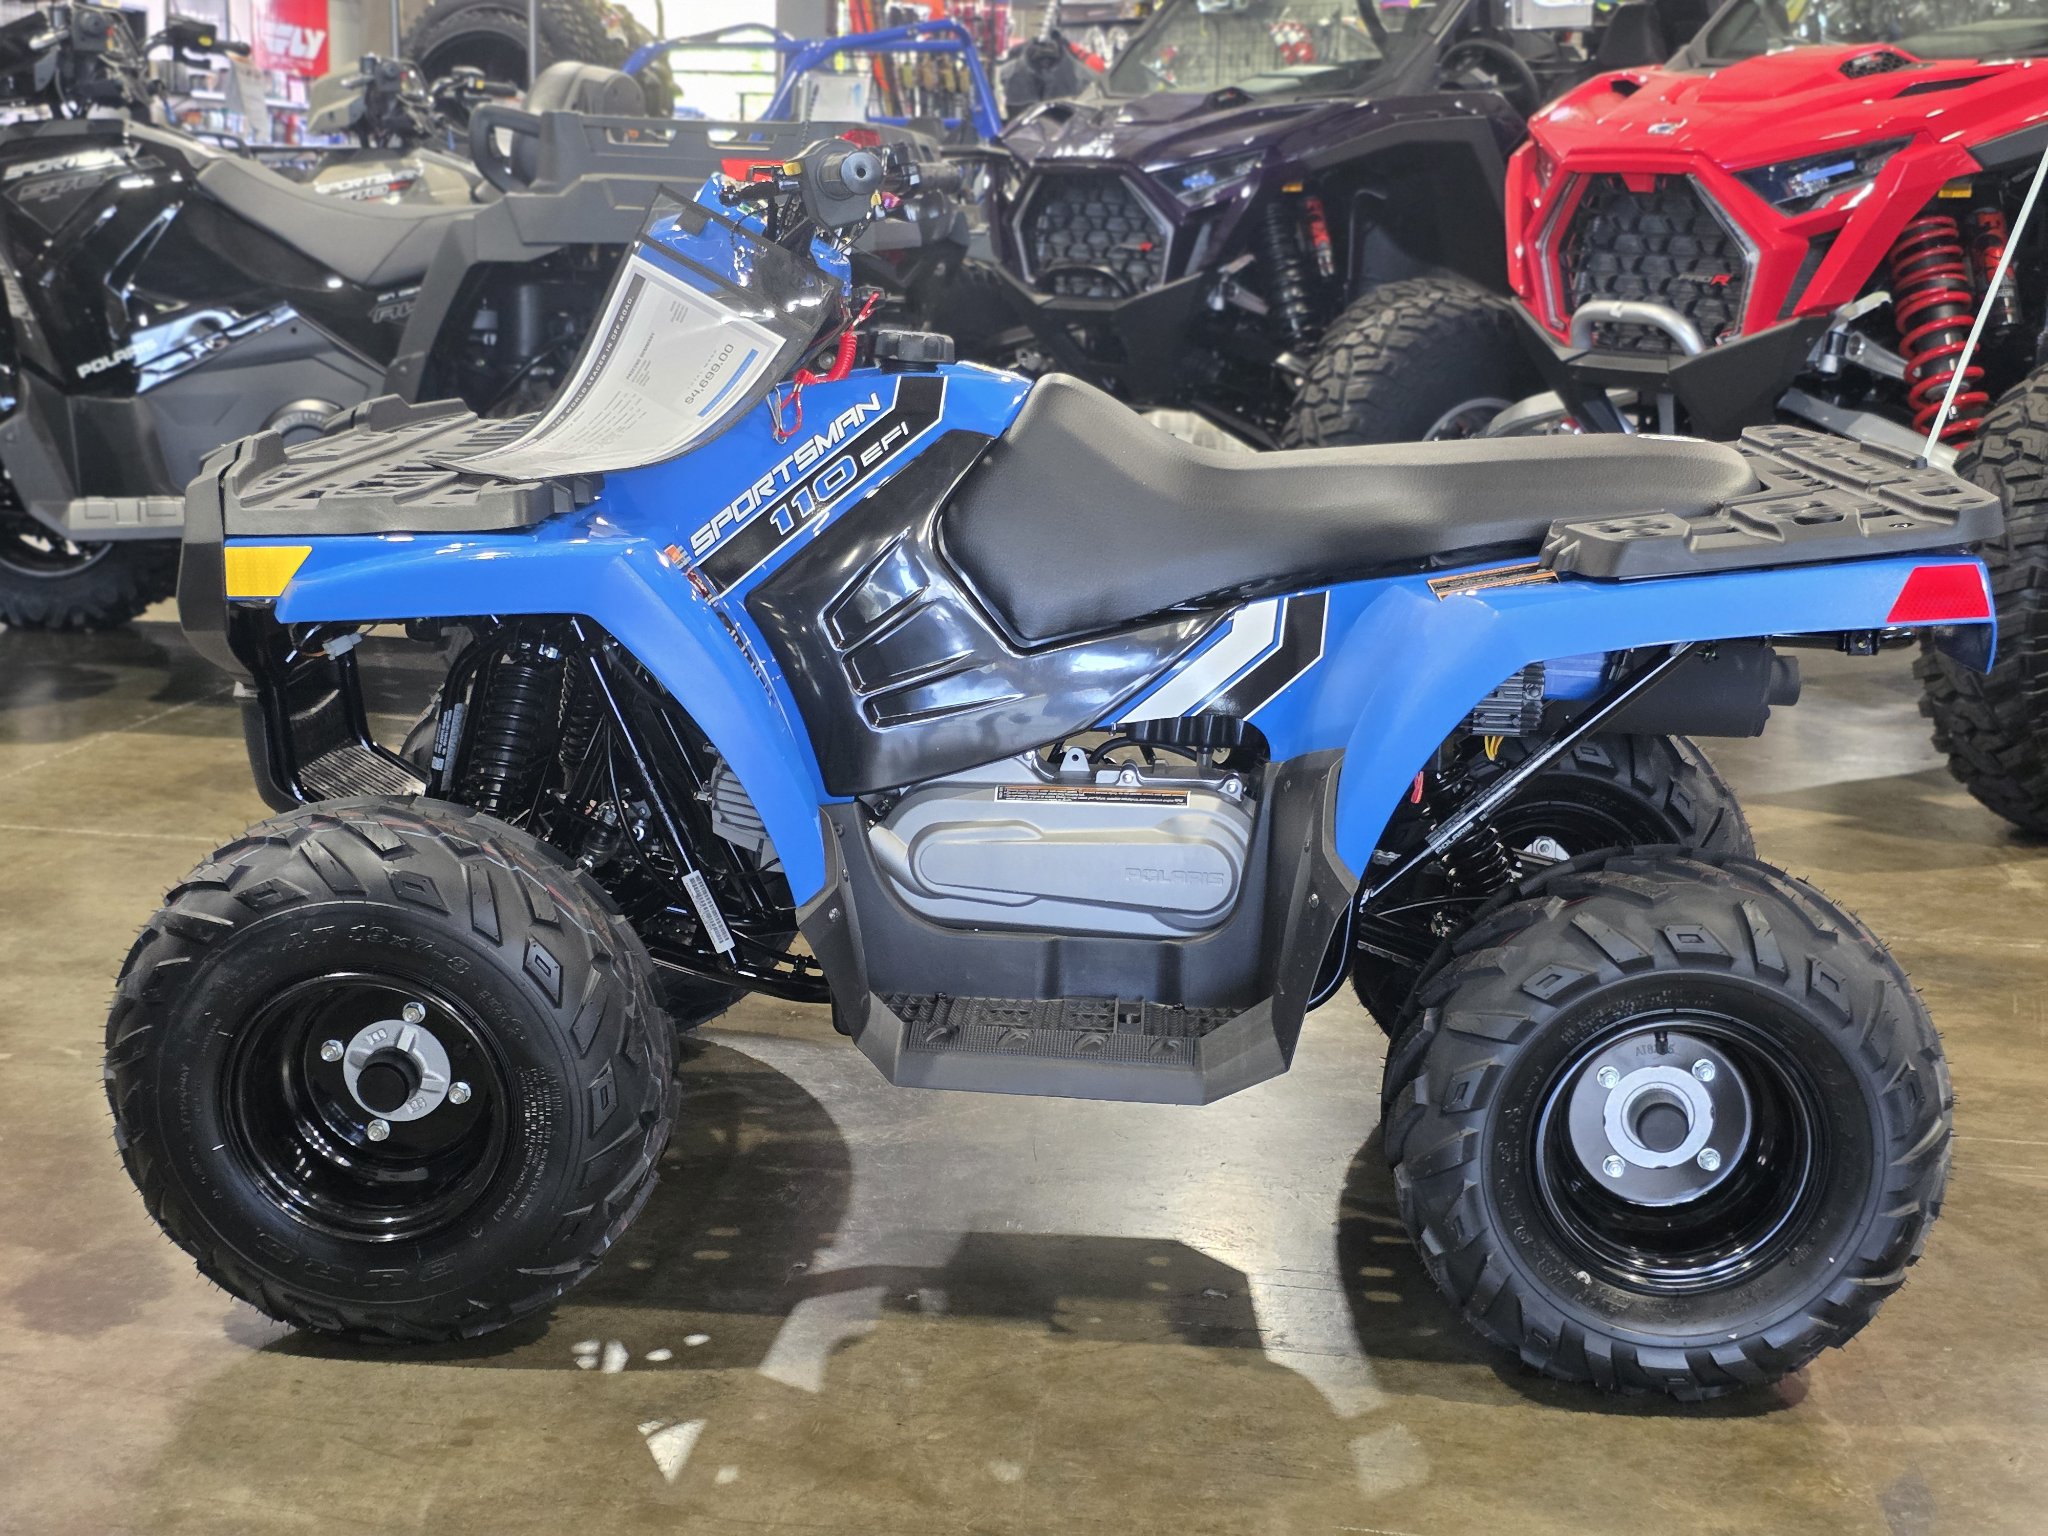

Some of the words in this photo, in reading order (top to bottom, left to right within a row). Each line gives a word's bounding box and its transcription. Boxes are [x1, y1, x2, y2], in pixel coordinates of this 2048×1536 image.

[76, 339, 158, 379] POLARIS
[565, 387, 588, 414] WORLD
[586, 354, 607, 385] LEADER
[605, 342, 613, 353] IN
[610, 323, 621, 341] OFF
[684, 343, 734, 405] $4,699.00
[690, 392, 882, 558] SPORTSMAN
[769, 454, 859, 536] 110
[859, 420, 910, 468] EFI
[1435, 821, 1475, 854] POLARIS
[1124, 866, 1225, 887] POLARIS
